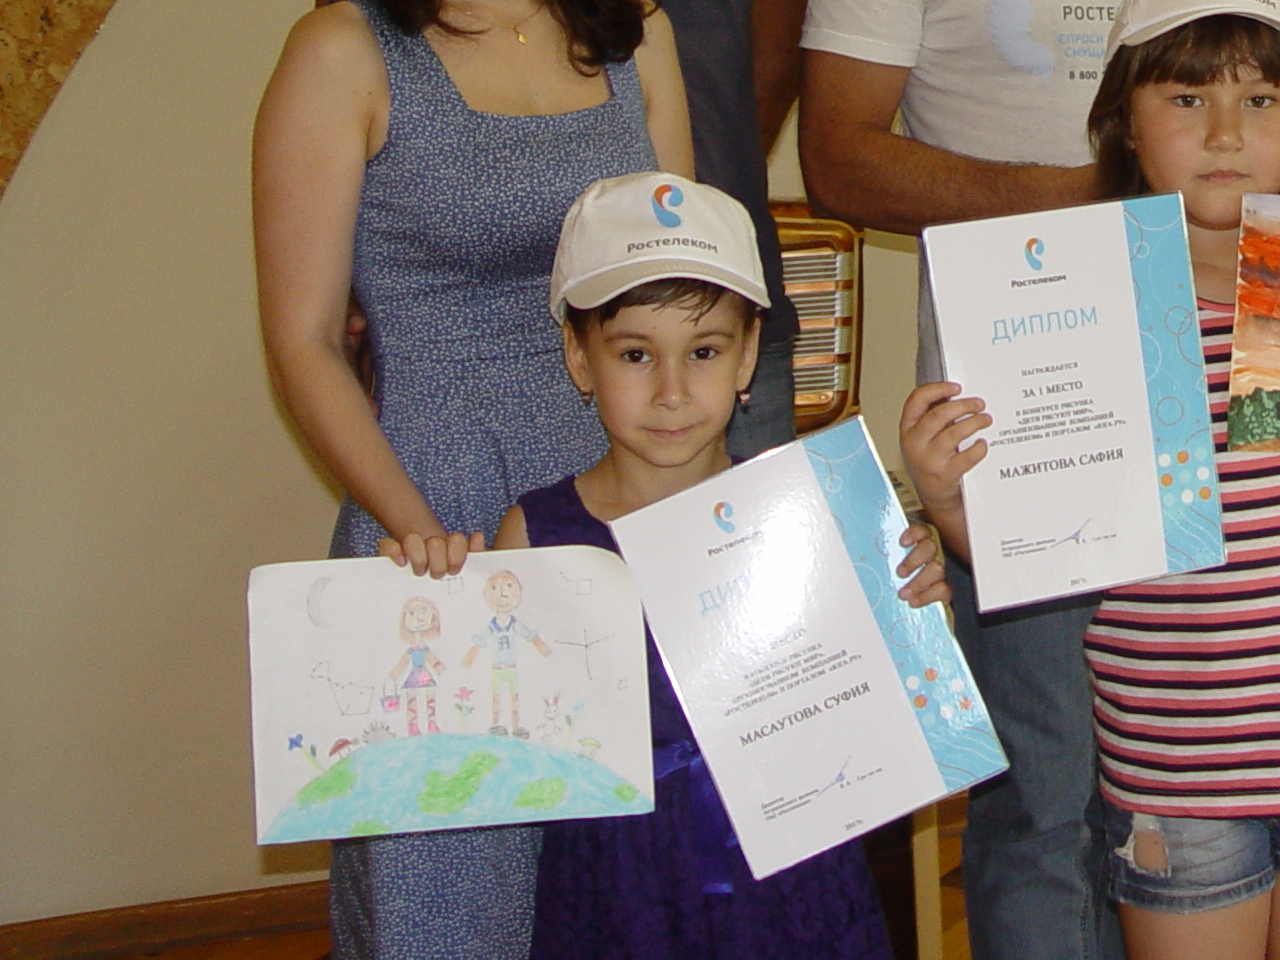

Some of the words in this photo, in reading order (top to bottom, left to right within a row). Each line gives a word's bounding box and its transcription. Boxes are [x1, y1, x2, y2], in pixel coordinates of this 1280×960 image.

[1062, 5, 1118, 21] РОСТЕ
[627, 237, 718, 254] Ростелеком
[1010, 273, 1067, 289] Ростелеком
[991, 305, 1099, 345] ДИПЛОМ
[1021, 361, 1078, 377] НАГРАЖДАЕТСЯ
[1021, 387, 1035, 398] ЗА
[1045, 379, 1083, 394] МЕСТО
[998, 455, 1076, 480] МАЖИТОВА
[1078, 446, 1123, 465] САФИЯ
[738, 701, 823, 747] МАСАУТОВА
[821, 680, 871, 711] СУФИЯ
